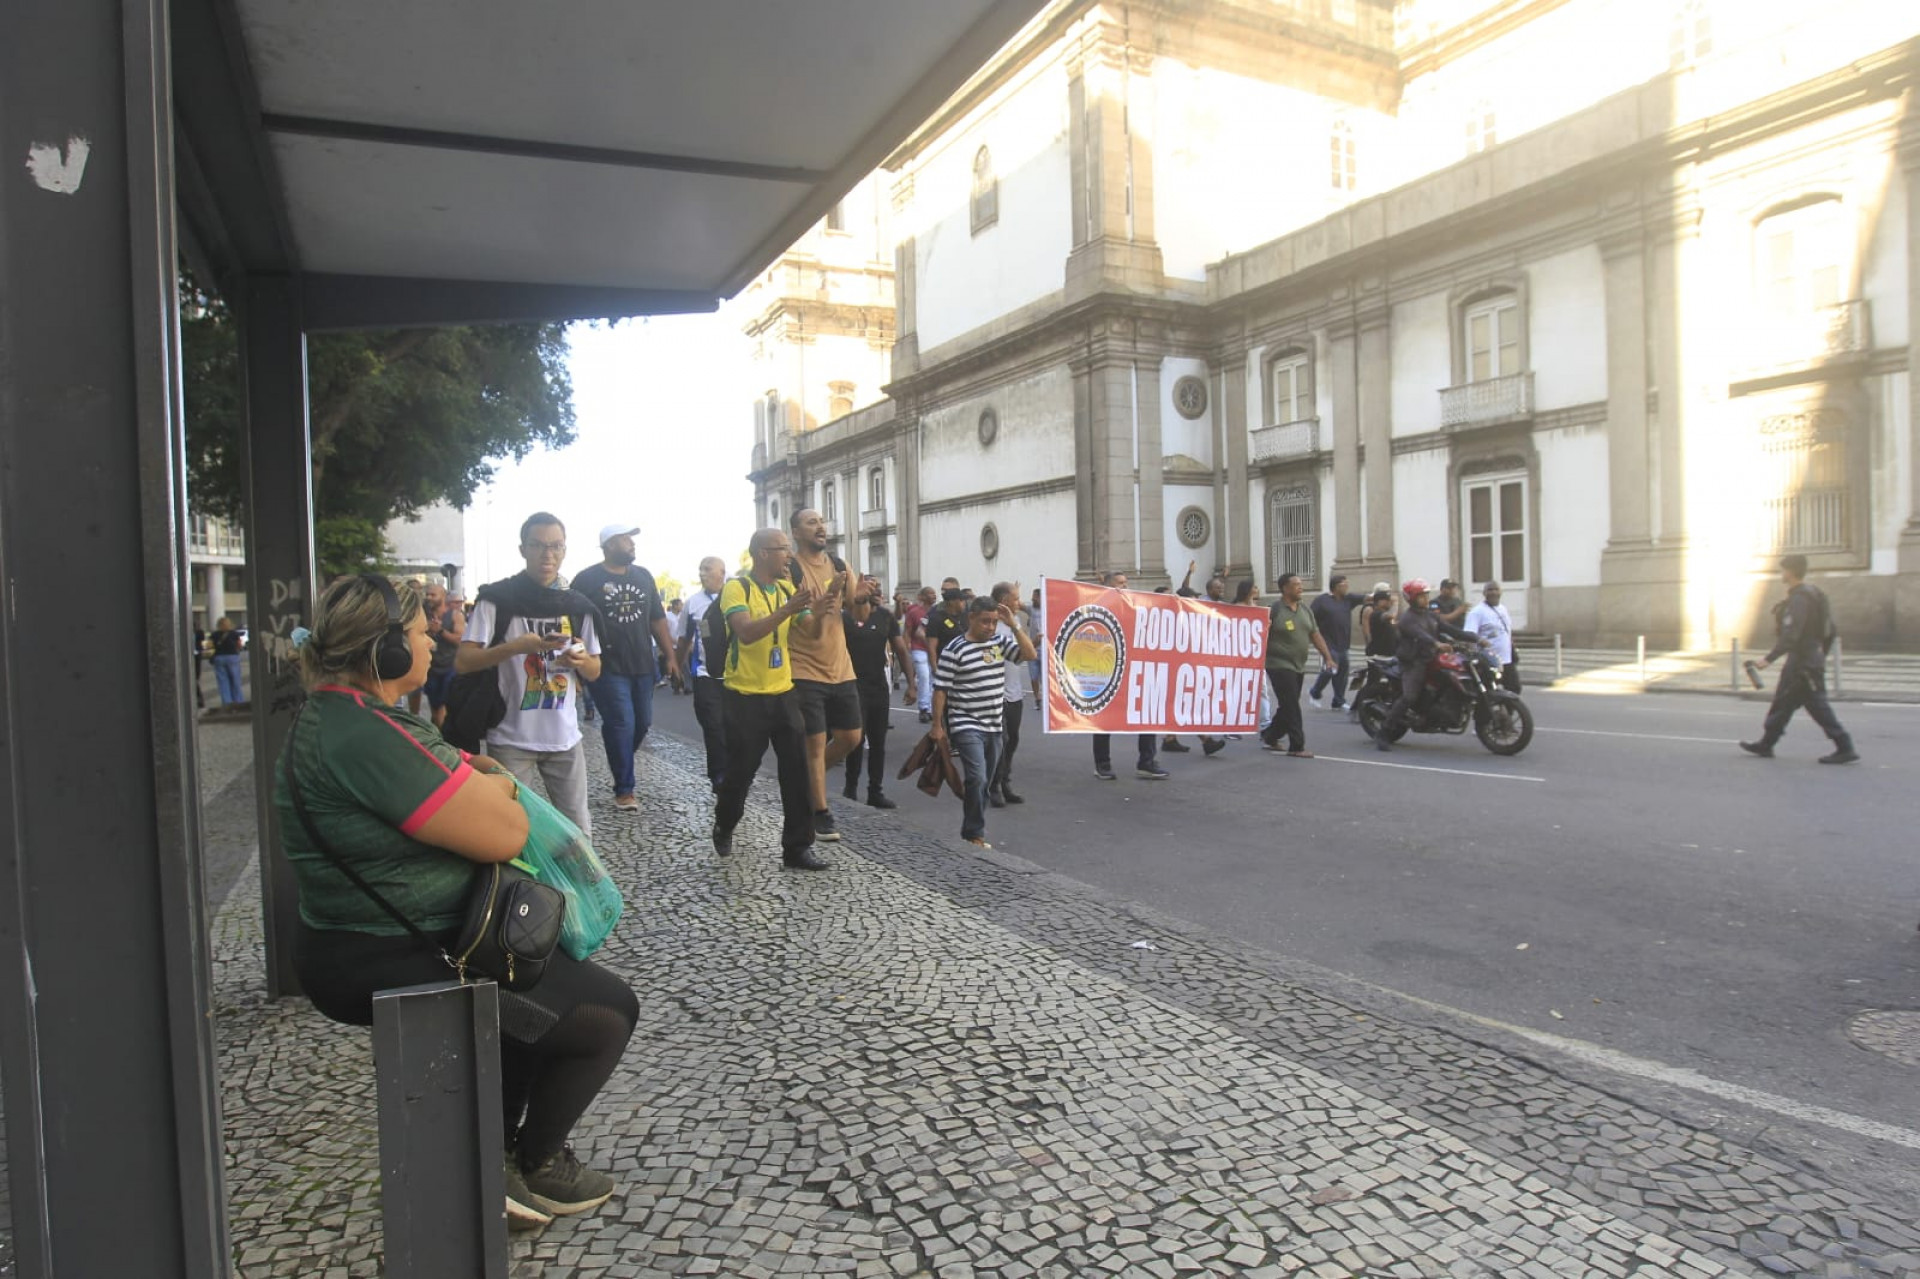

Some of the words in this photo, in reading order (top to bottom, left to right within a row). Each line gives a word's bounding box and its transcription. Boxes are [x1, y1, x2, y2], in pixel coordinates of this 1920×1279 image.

[1133, 606, 1263, 659] RODOVIÁRIOS
[1126, 660, 1170, 725] EM
[1173, 663, 1261, 727] GREVE!
